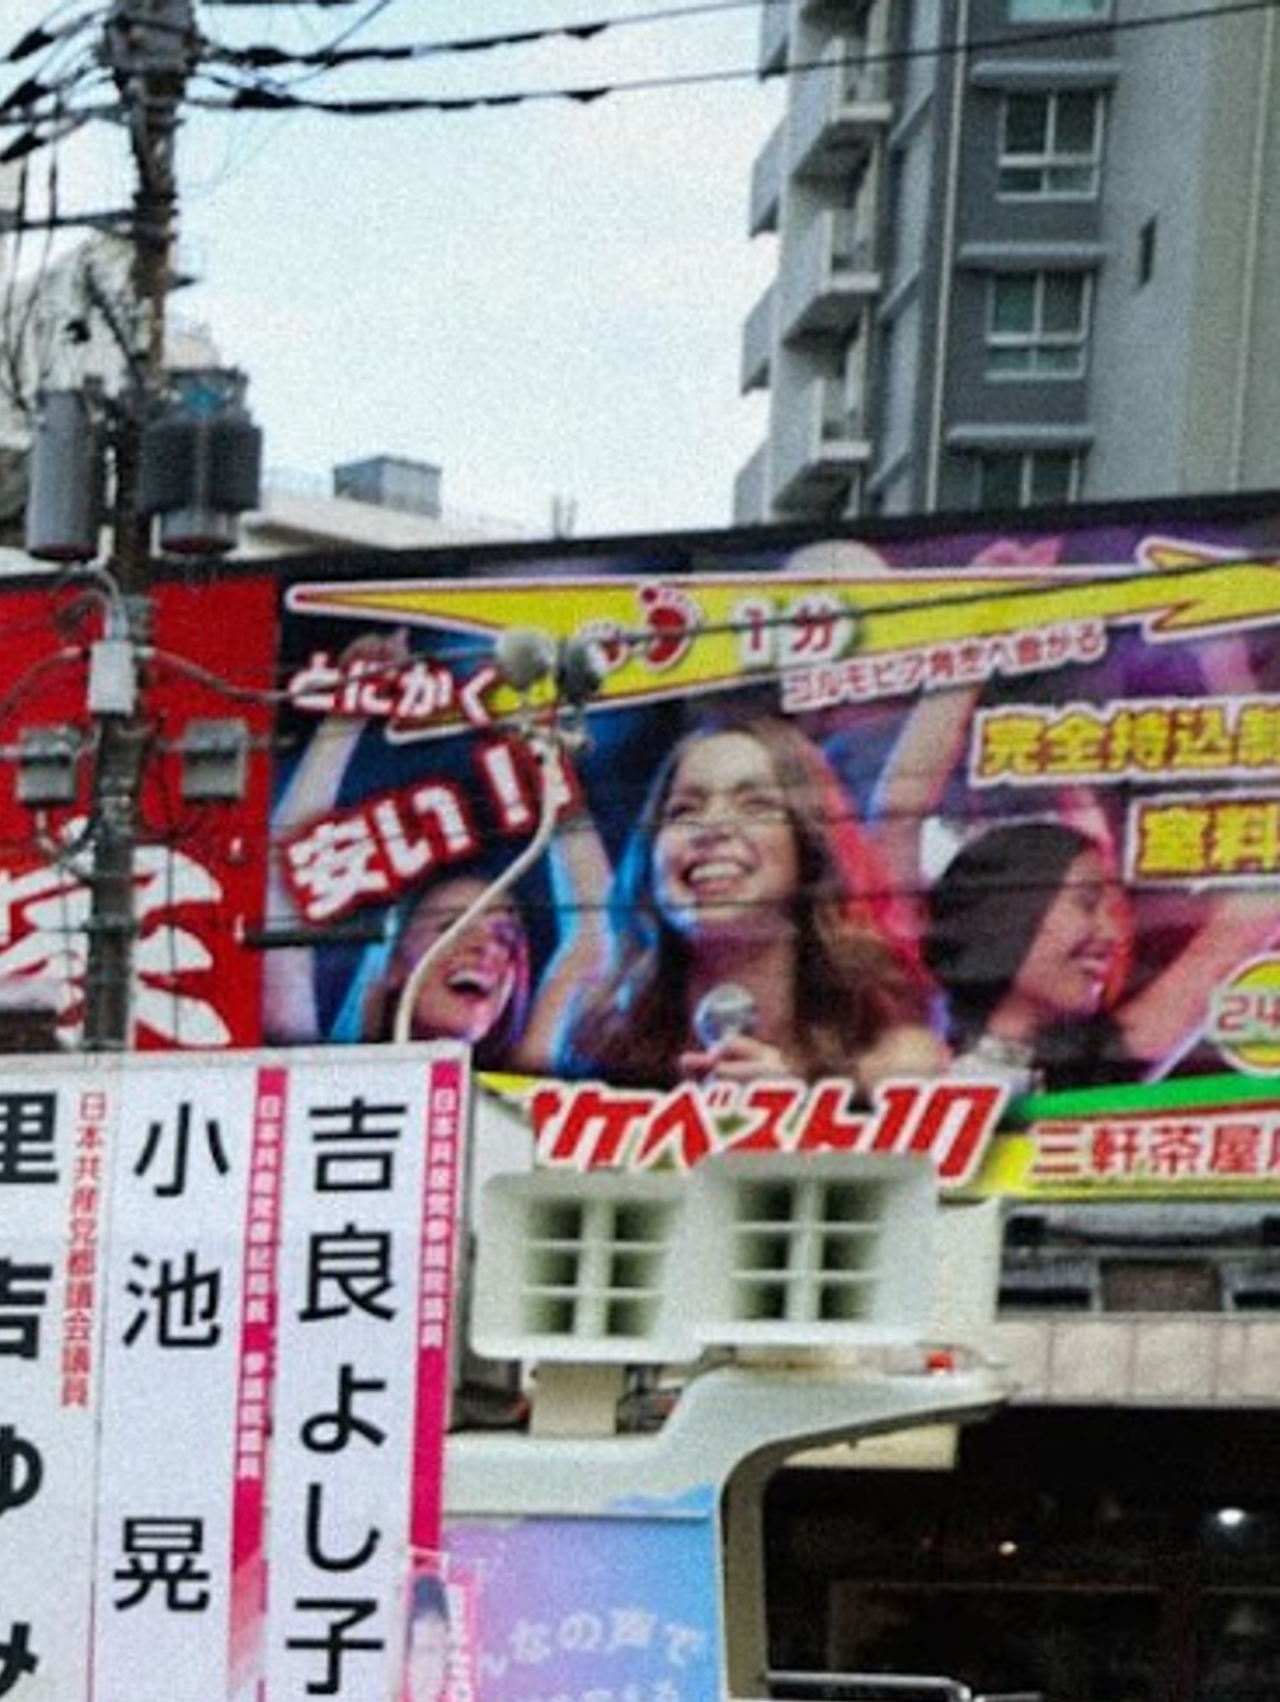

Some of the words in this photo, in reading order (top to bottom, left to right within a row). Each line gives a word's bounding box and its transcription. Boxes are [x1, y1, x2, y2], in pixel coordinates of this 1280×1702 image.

[289, 652, 496, 726] とにかく
[1032, 1122, 1280, 1173] 三軒茶屋
[285, 1096, 410, 1696] 吉良よし子
